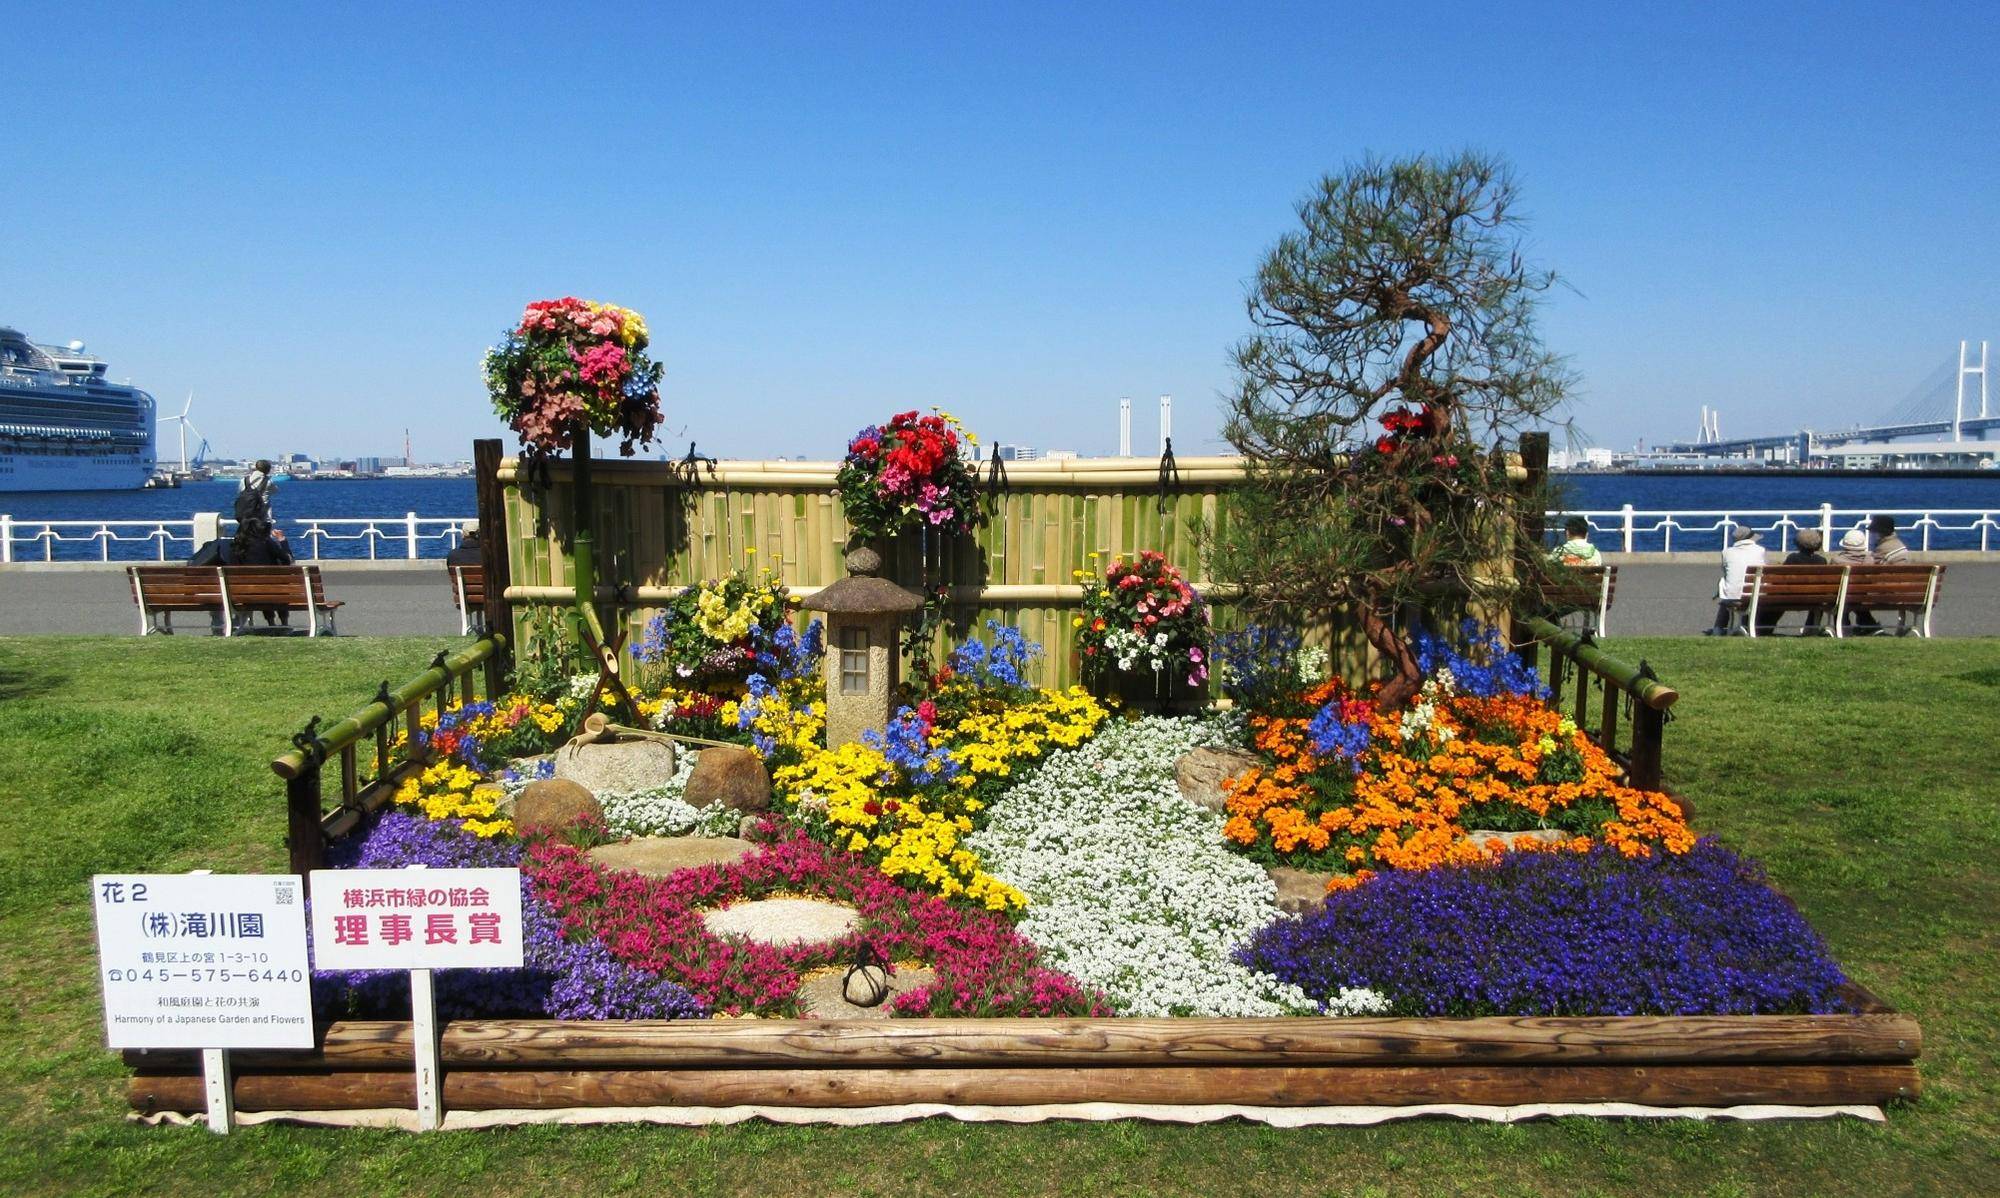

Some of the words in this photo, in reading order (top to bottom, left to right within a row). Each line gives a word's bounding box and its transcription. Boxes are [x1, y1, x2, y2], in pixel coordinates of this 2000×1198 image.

[343, 887, 489, 908] 横浜市緑の協会
[142, 912, 264, 938] (株)滝川園
[333, 912, 502, 946] 理事長賞
[115, 1014, 154, 1025] Harmony
[157, 1014, 166, 1024] of
[168, 1016, 173, 1024] a
[176, 1014, 216, 1025] Japanese
[219, 1014, 250, 1024] Garden
[252, 1014, 268, 1024] and
[271, 1015, 305, 1025] Flowers
